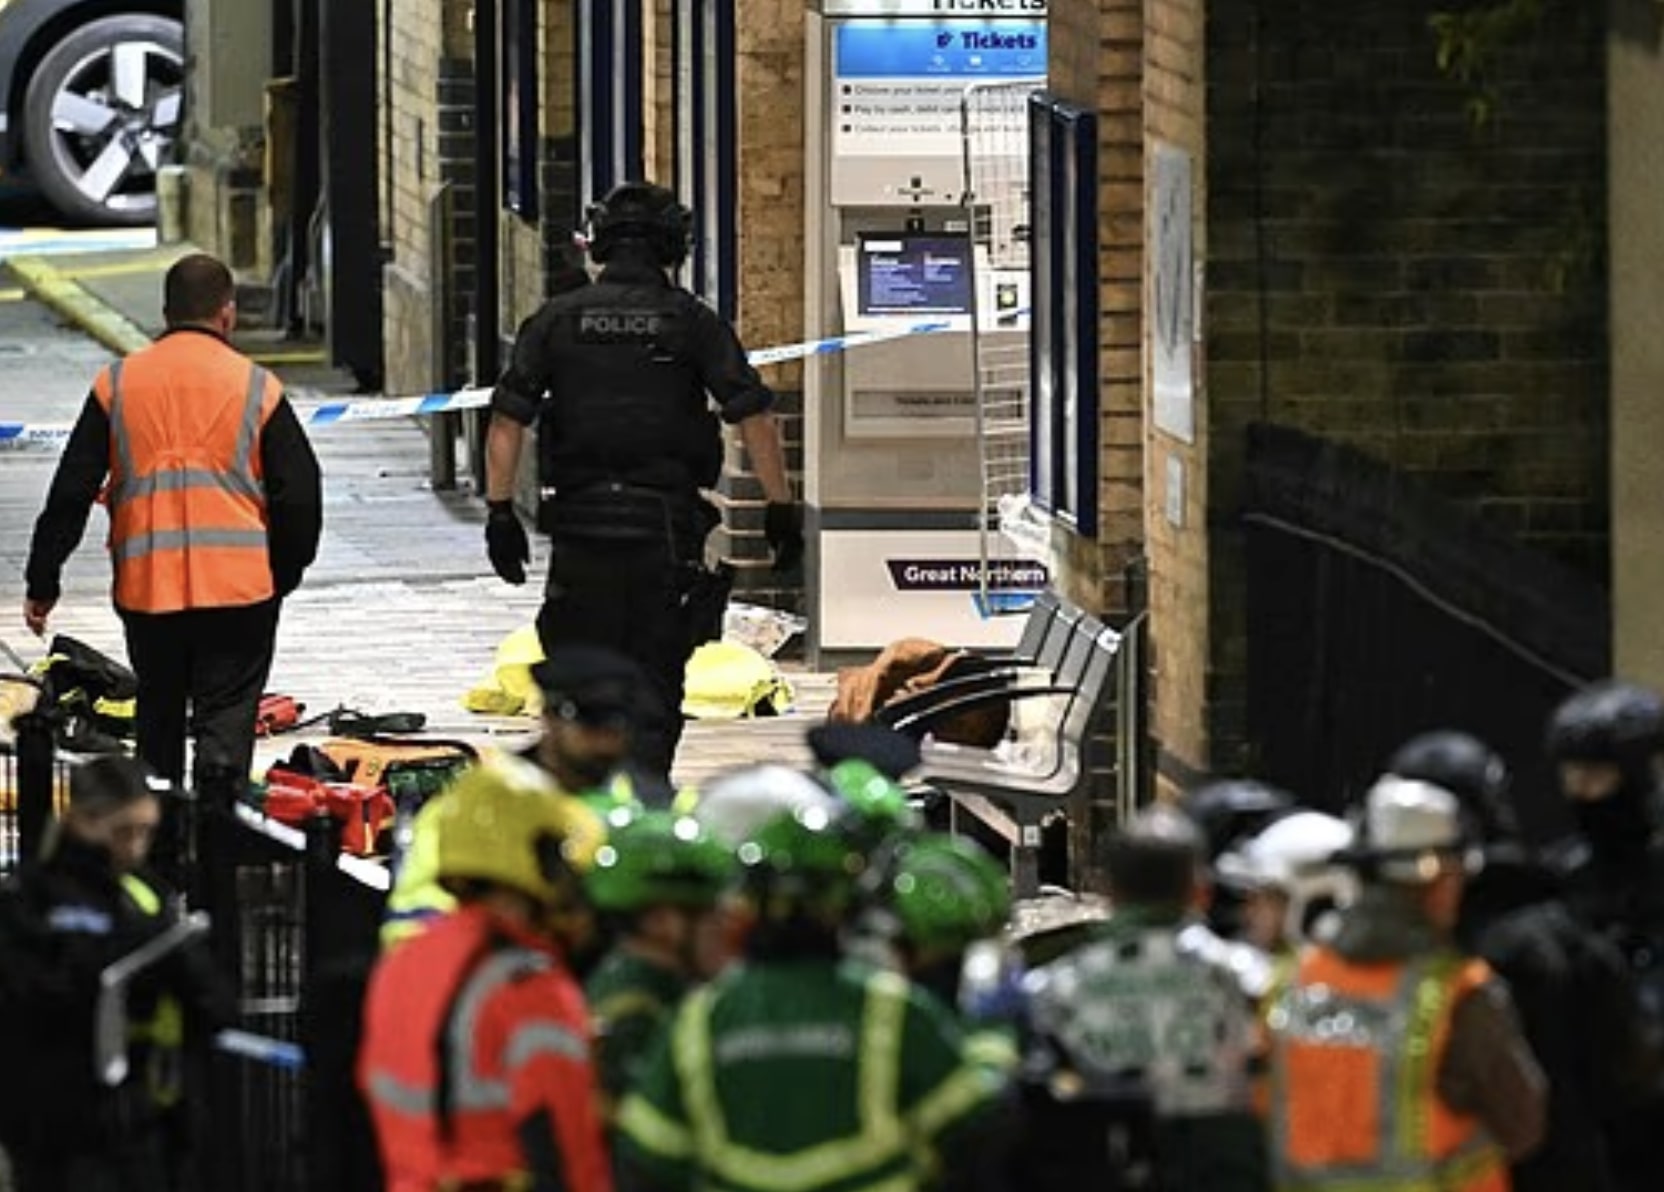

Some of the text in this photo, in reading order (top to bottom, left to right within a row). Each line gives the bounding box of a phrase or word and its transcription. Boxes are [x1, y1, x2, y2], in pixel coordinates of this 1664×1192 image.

[961, 31, 1037, 49] Tickets
[581, 316, 660, 335] POLICE
[904, 565, 1045, 583] Great Northern
